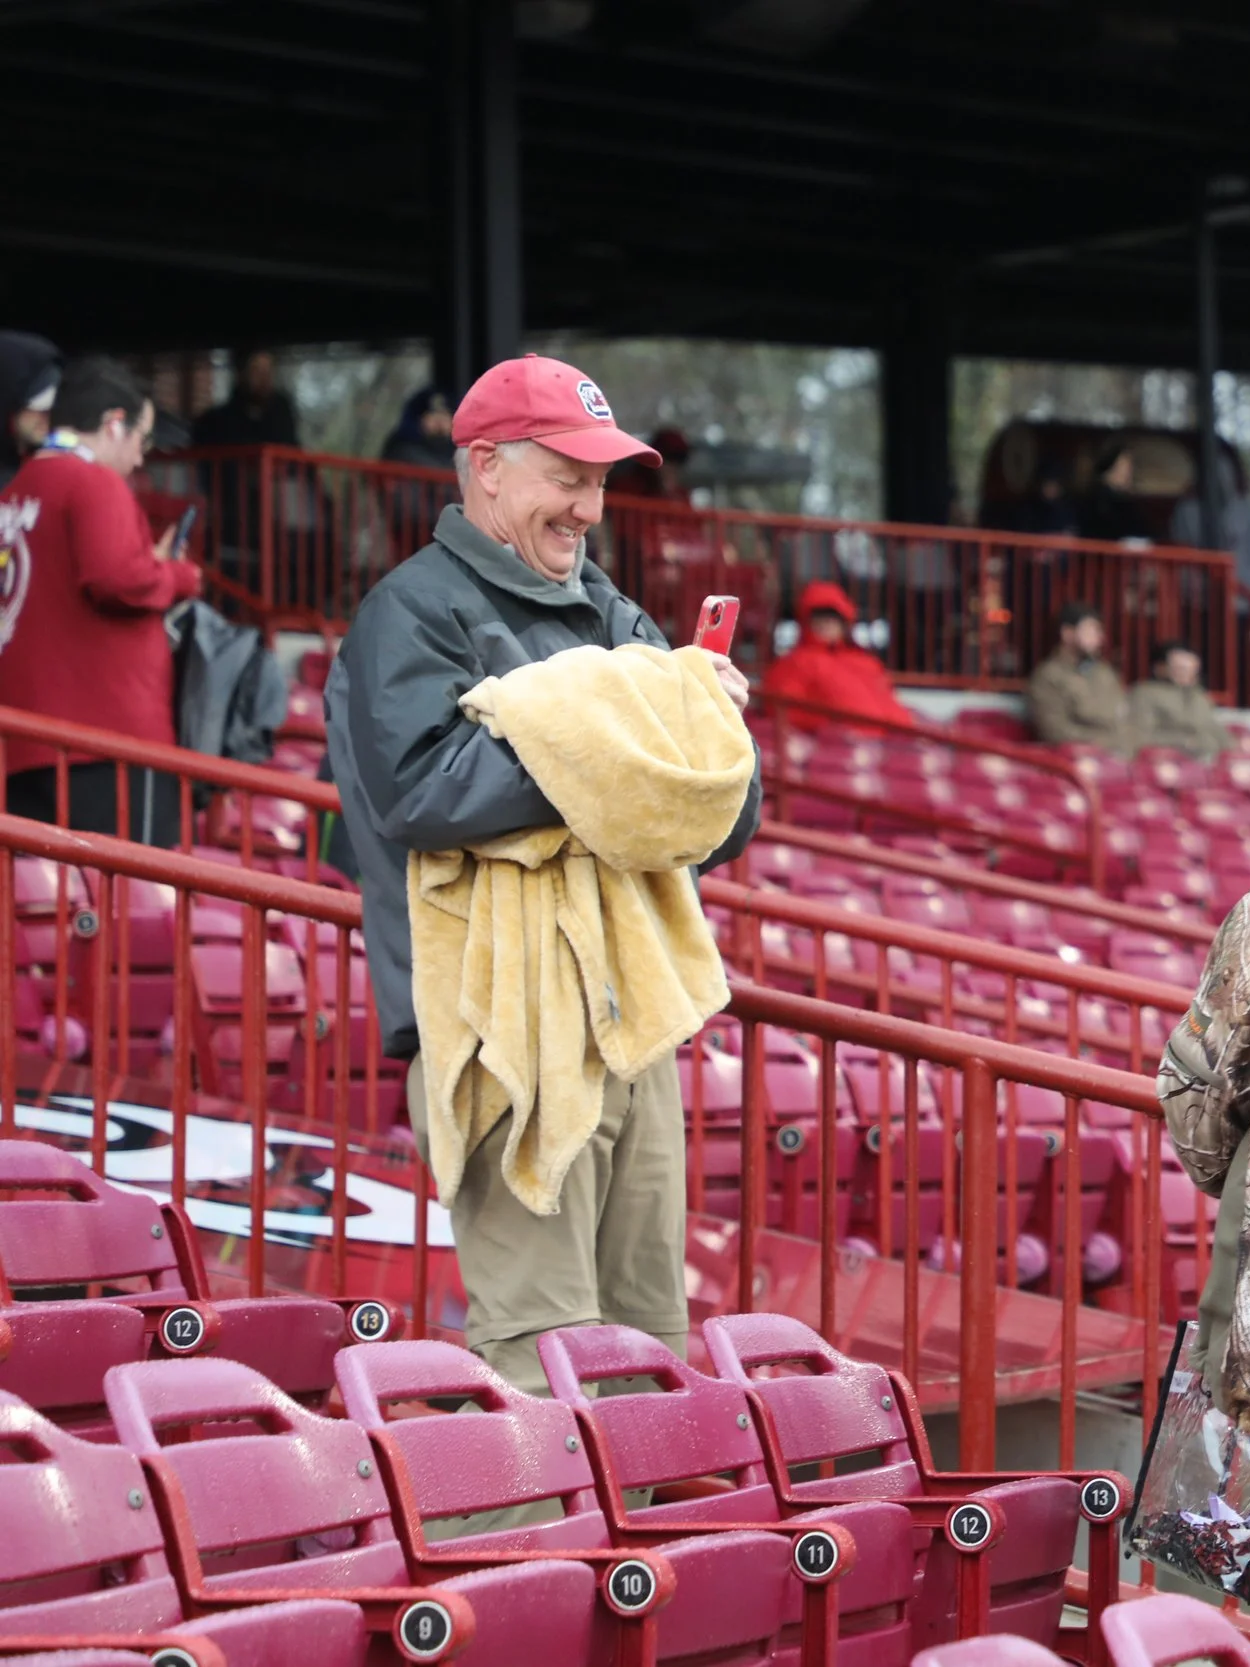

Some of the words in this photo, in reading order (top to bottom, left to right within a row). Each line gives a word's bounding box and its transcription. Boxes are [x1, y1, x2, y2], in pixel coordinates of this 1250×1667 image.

[174, 1320, 192, 1338] 12
[361, 1313, 379, 1330] 13
[1092, 1489, 1109, 1506] 13
[961, 1517, 980, 1535] 12
[807, 1545, 824, 1564] 11
[621, 1574, 642, 1596] 10
[419, 1615, 432, 1641] 9
